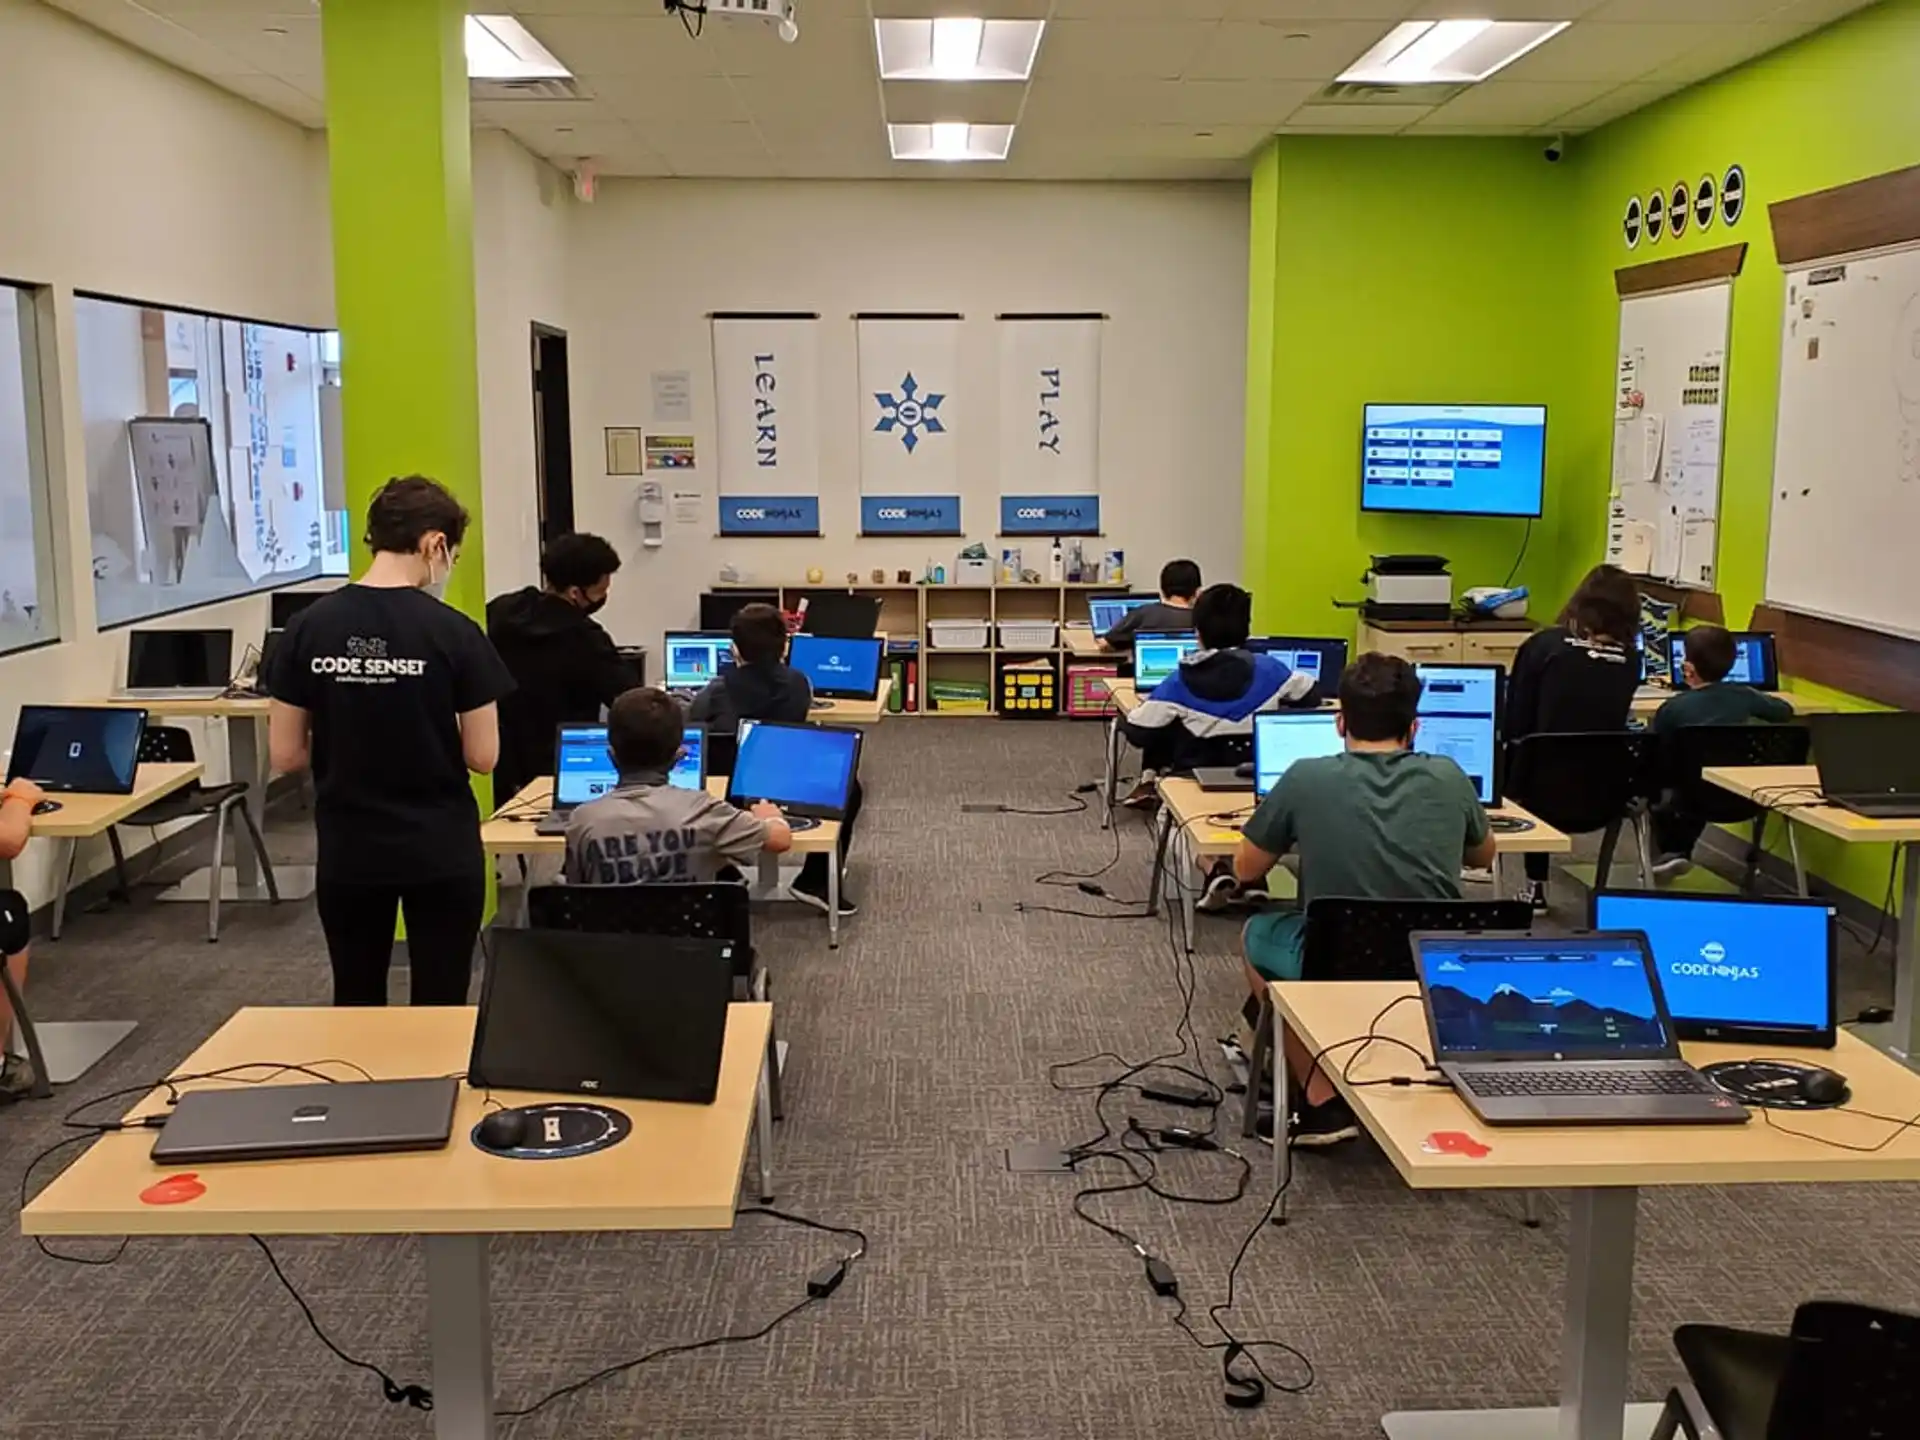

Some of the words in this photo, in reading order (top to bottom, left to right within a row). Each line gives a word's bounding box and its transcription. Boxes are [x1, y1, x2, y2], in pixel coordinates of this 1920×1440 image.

[754, 354, 777, 467] LEARN
[1039, 368, 1061, 455] PLAY
[311, 656, 362, 674] CODE
[586, 833, 639, 862] ARE
[646, 828, 697, 854] YOU
[1671, 962, 1709, 976] CODE
